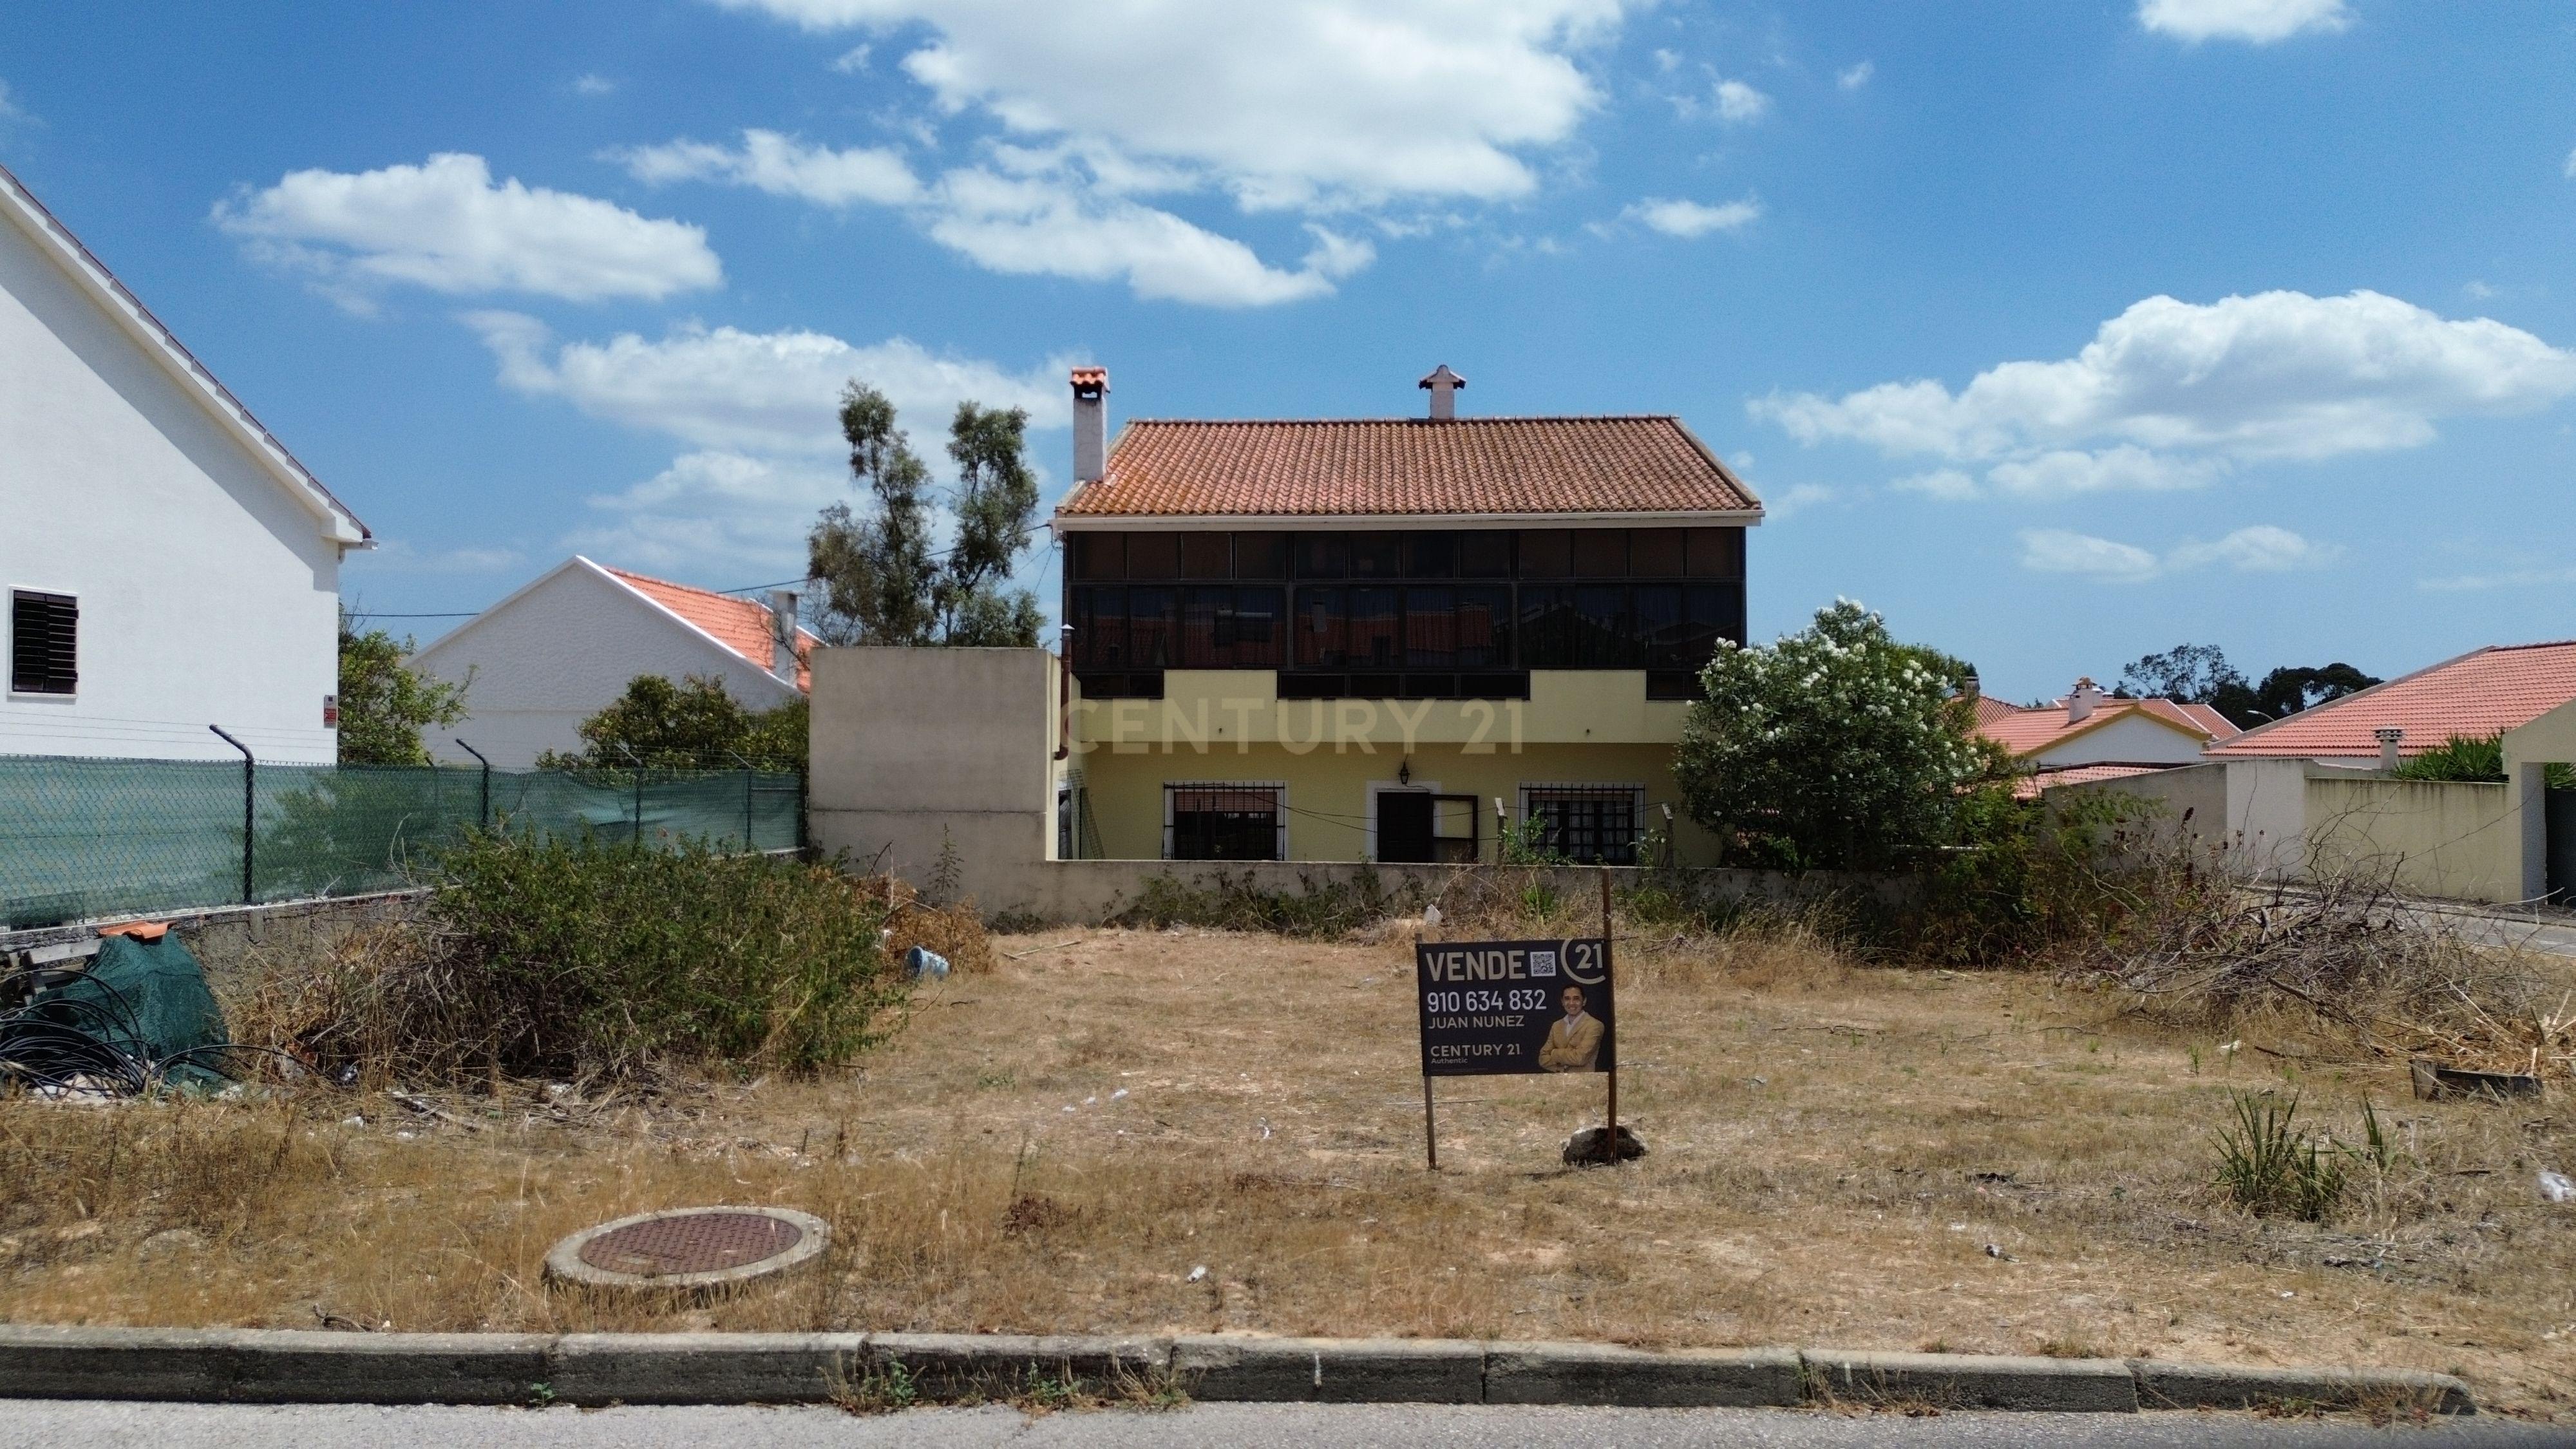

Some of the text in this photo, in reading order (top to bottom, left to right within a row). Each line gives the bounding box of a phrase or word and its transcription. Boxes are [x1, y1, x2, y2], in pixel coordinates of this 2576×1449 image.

[1426, 950, 1526, 981] VENDE
[1428, 989, 1547, 1012] 910 634 832
[1428, 1015, 1525, 1029] JUAN NUNEZ
[1430, 1043, 1520, 1057] CENTURY 21
